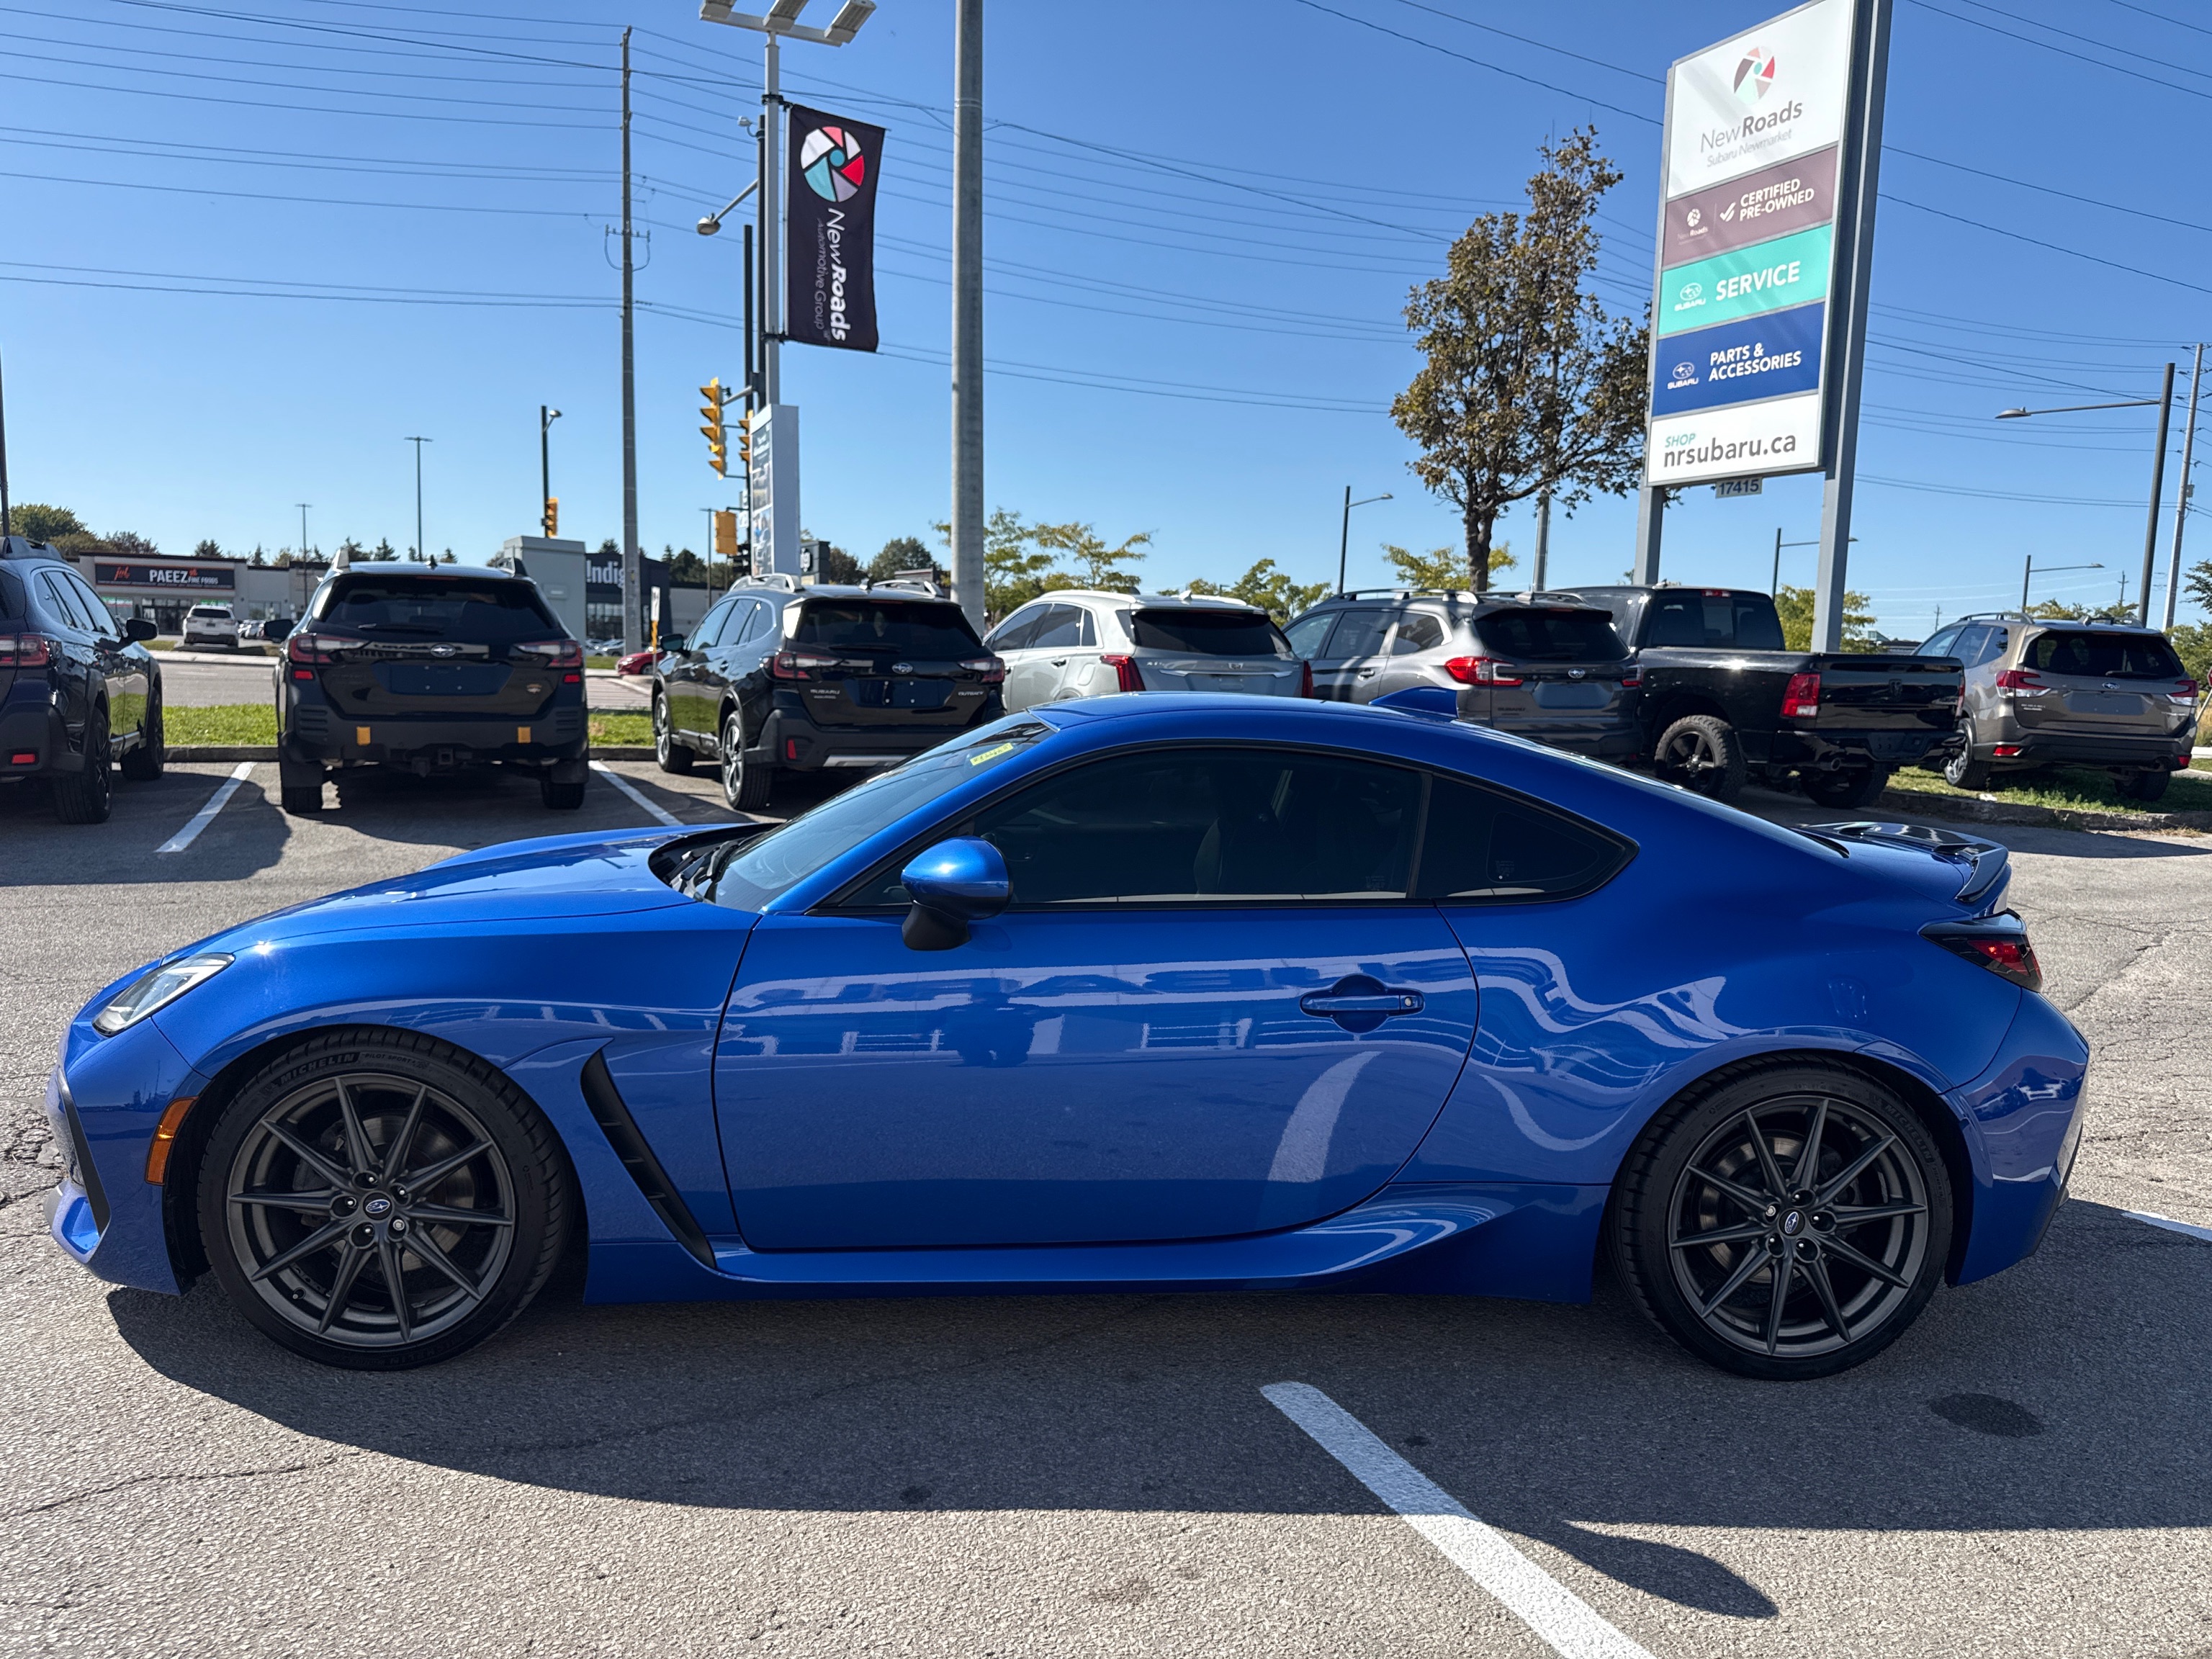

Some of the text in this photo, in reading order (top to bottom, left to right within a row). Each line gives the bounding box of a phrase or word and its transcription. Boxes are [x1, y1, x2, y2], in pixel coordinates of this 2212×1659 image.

[1707, 129, 1791, 168] Subaru Newmarket
[1739, 188, 1815, 222] PRE-OWNED
[1740, 178, 1801, 207] CERTIFIED
[814, 217, 828, 331] Automotive Group
[1716, 261, 1801, 301] SERVICE
[1674, 297, 1707, 311] SUBARU
[1709, 342, 1764, 366] PARTS &
[1709, 351, 1802, 382] ACCESSORIES
[1667, 377, 1699, 390] SUBARU
[1663, 434, 1797, 468] nrsubaru.ca
[1665, 433, 1696, 448] SHOP
[1719, 479, 1759, 495] 17415
[149, 569, 189, 584] PAEEZ
[280, 1053, 355, 1084] MICHELIN
[387, 1055, 413, 1064] SPORT
[1885, 1105, 1932, 1159] MICHELIN
